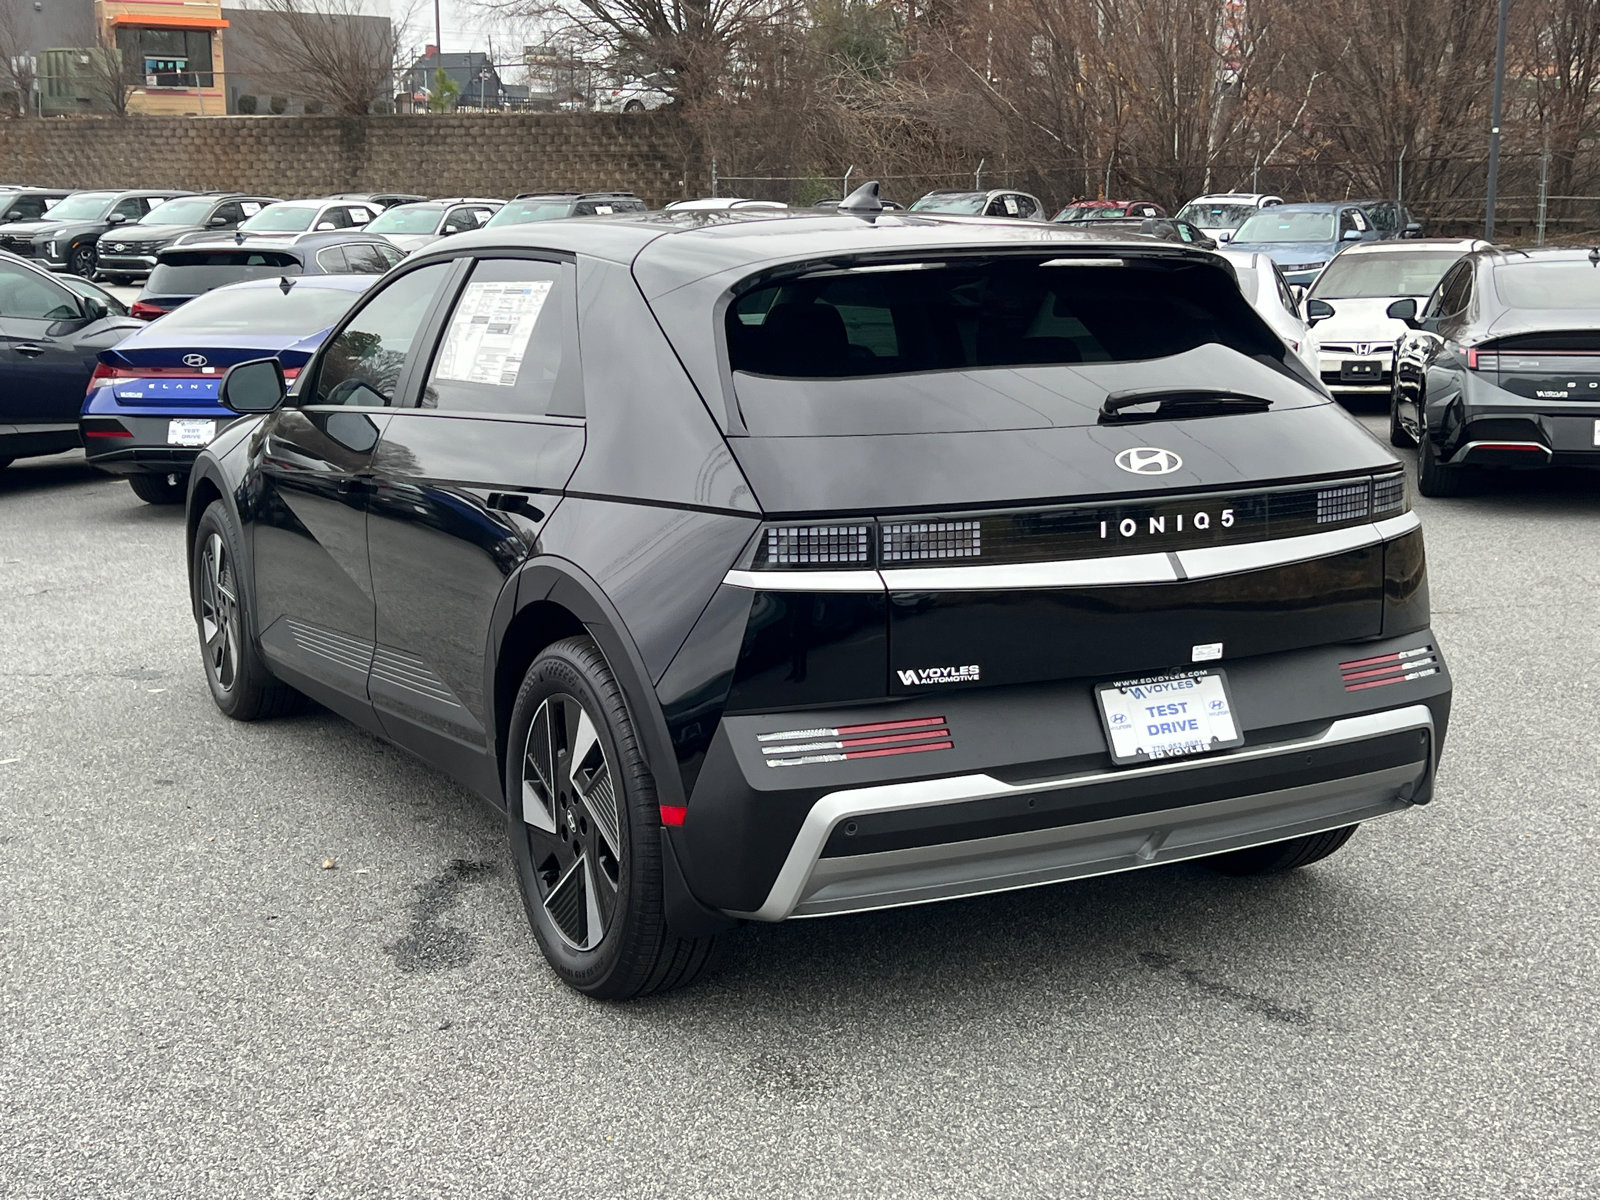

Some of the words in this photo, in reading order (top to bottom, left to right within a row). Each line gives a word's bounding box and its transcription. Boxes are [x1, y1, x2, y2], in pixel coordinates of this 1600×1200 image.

[919, 665, 980, 678] VOYLES
[920, 674, 980, 684] AUTOMOTIVE
[1144, 680, 1194, 694] VOYLES
[1146, 702, 1187, 717] TEST
[1147, 718, 1199, 736] DRIVE
[1149, 751, 1165, 760] ED
[1166, 743, 1211, 757] VOYLES
